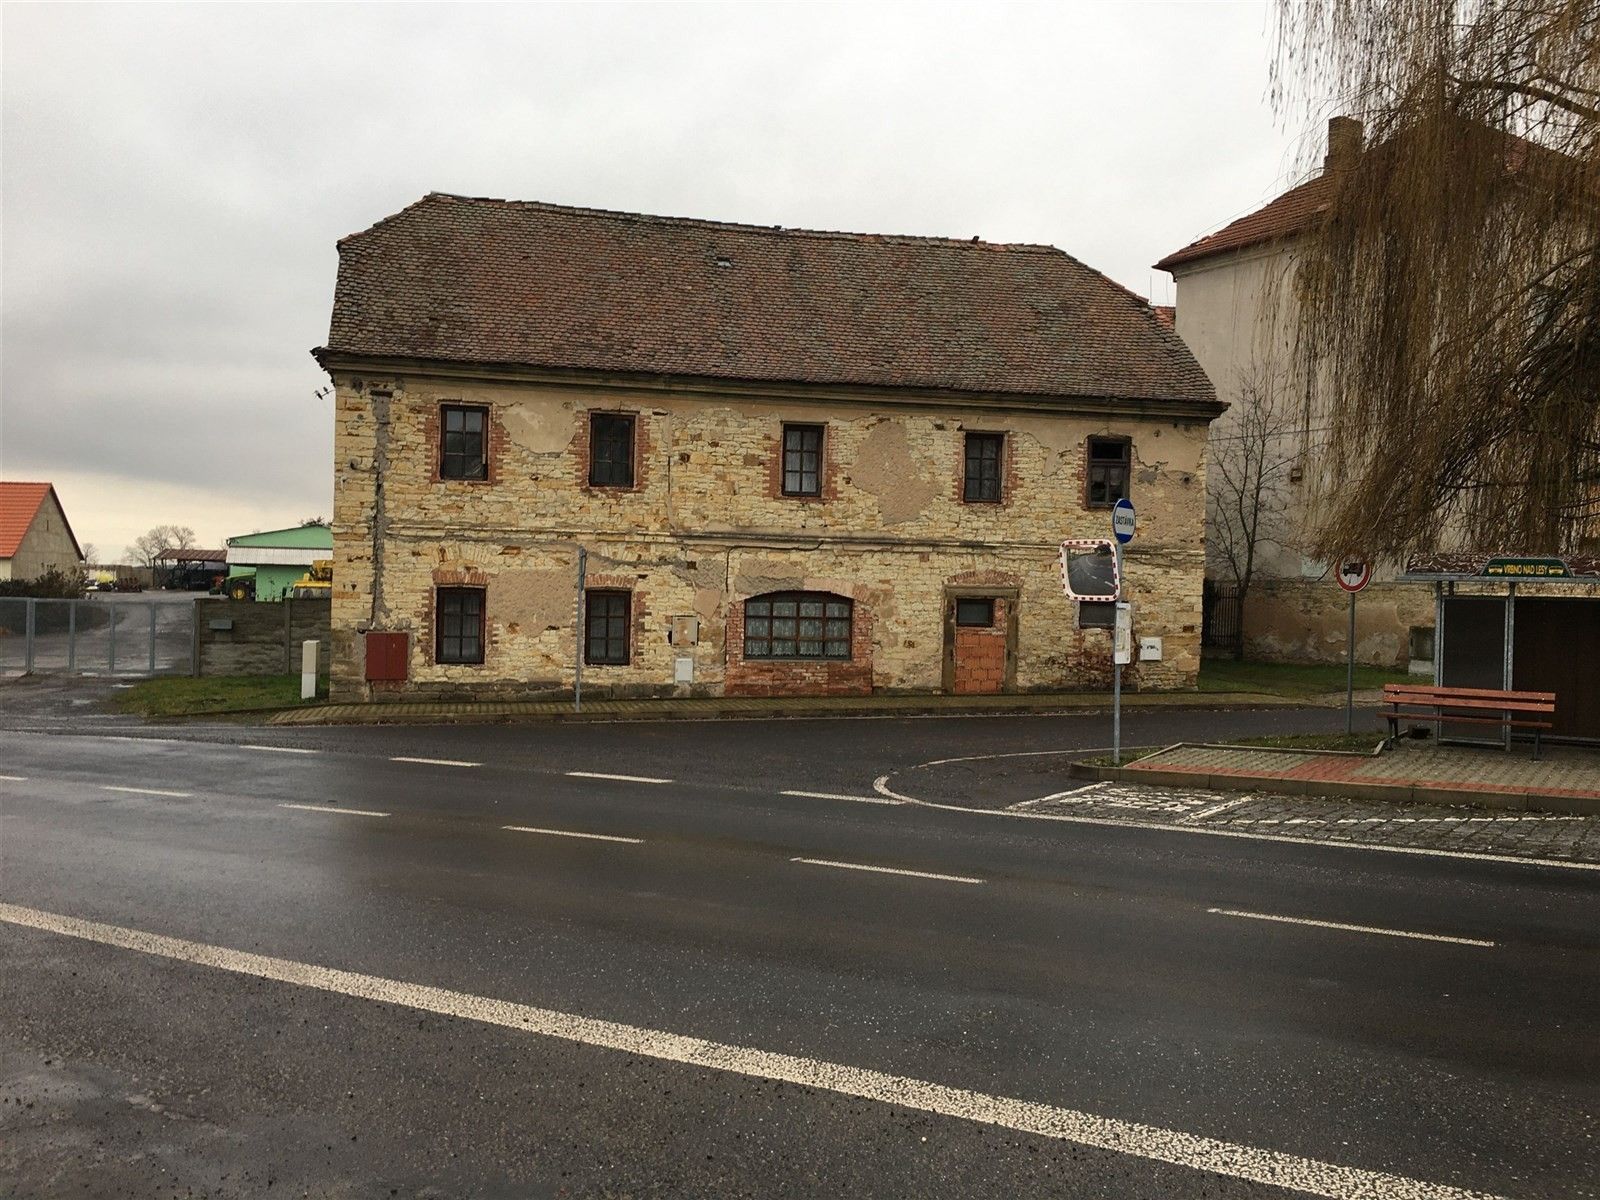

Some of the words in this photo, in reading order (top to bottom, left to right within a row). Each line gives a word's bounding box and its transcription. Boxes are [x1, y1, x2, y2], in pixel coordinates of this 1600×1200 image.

[1115, 515, 1134, 526] ZASTÁVKA
[1523, 565, 1535, 574] NAD
[1535, 565, 1548, 575] LESY
